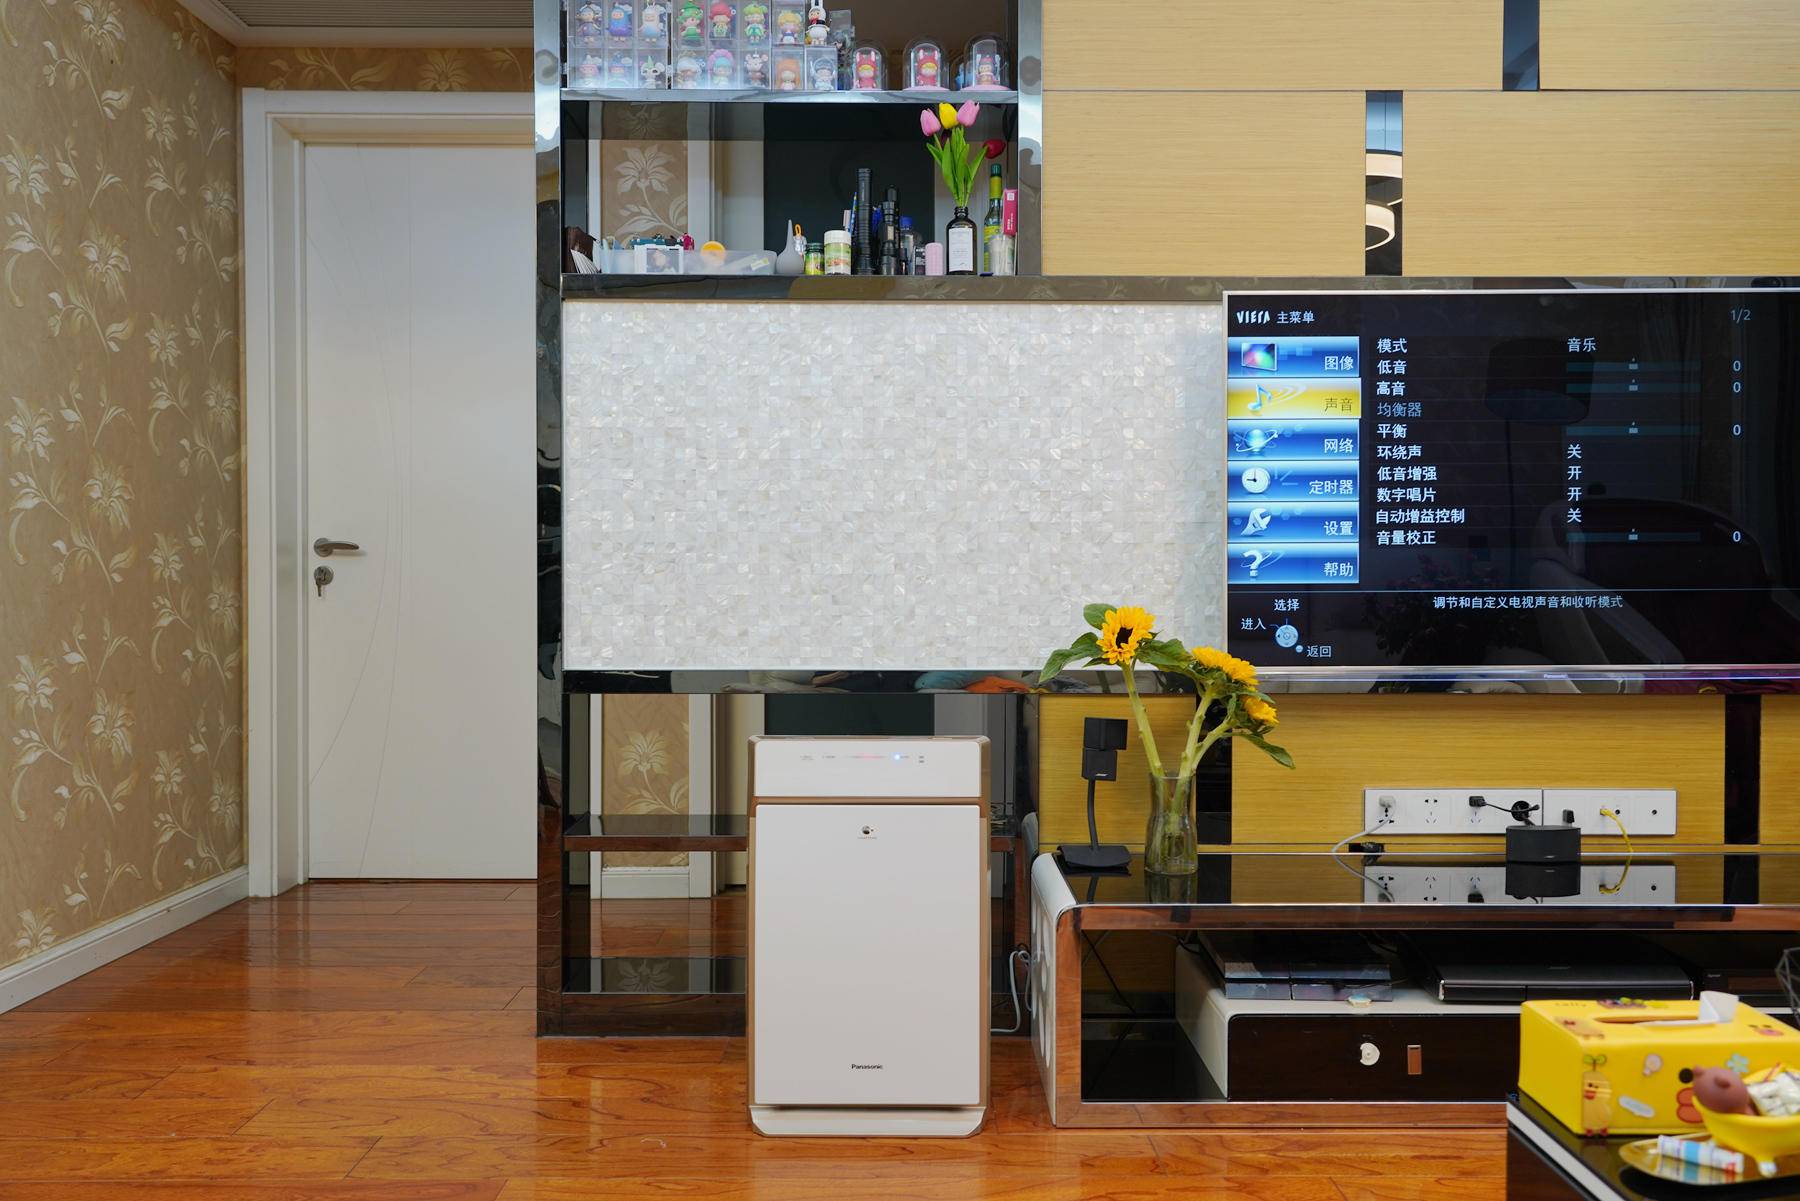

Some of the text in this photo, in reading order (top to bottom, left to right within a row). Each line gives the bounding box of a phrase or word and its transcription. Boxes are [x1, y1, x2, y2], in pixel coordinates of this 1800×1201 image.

[1277, 311, 1315, 324] 主菜单
[1731, 310, 1751, 323] 1/2
[1377, 338, 1408, 354] 模式
[1567, 338, 1596, 352] 音乐
[1324, 356, 1354, 371] 图像
[1377, 360, 1407, 375] 低音
[1733, 361, 1741, 372] 0
[1377, 381, 1406, 396] 高音
[1733, 382, 1741, 393] 0
[1324, 398, 1353, 412] 声音
[1377, 402, 1421, 417] 均衡器
[1377, 424, 1407, 439] 平衡
[1733, 425, 1741, 435] 0
[1324, 439, 1354, 454] 网络
[1377, 445, 1421, 460] 环绕声
[1567, 444, 1582, 459] 关
[1377, 466, 1437, 482] 低音增强
[1567, 466, 1582, 480] 开
[1309, 480, 1354, 495] 定时器
[1567, 487, 1582, 501] 开
[1377, 488, 1437, 503] 数字唱片
[1376, 509, 1464, 524] 自动增益控制
[1567, 508, 1582, 523] 关
[1324, 521, 1354, 536] 设置
[1377, 530, 1437, 545] 音量校正
[1733, 531, 1741, 542] 0
[1324, 562, 1354, 577] 帮助
[1274, 598, 1299, 611] 选择
[1433, 596, 1624, 609] 调节和自定义电视声音和收听模式
[1241, 618, 1266, 630] 进入
[1307, 645, 1332, 657] 返回
